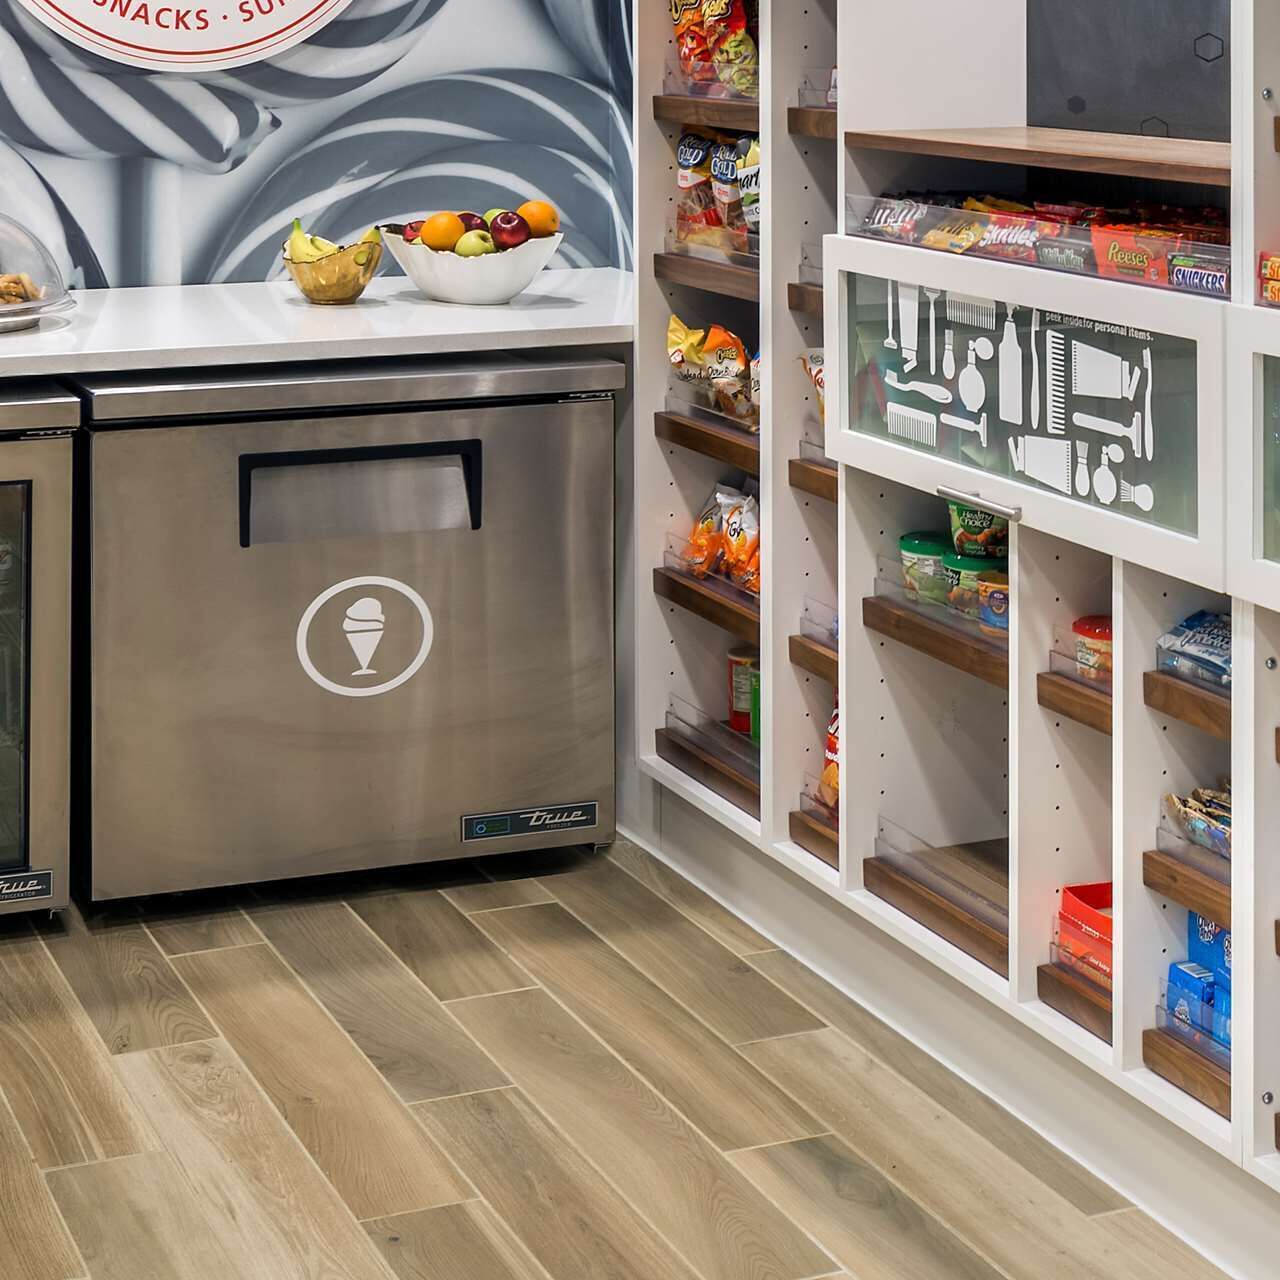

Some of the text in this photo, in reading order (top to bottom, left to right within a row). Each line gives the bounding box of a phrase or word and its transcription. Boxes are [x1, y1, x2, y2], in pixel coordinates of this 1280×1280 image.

[1174, 267, 1226, 293] SNICKERS
[1046, 311, 1062, 323] peek
[1063, 313, 1083, 327] inside
[1083, 317, 1094, 329] for
[1094, 321, 1127, 337] personal
[959, 516, 991, 528] Choice
